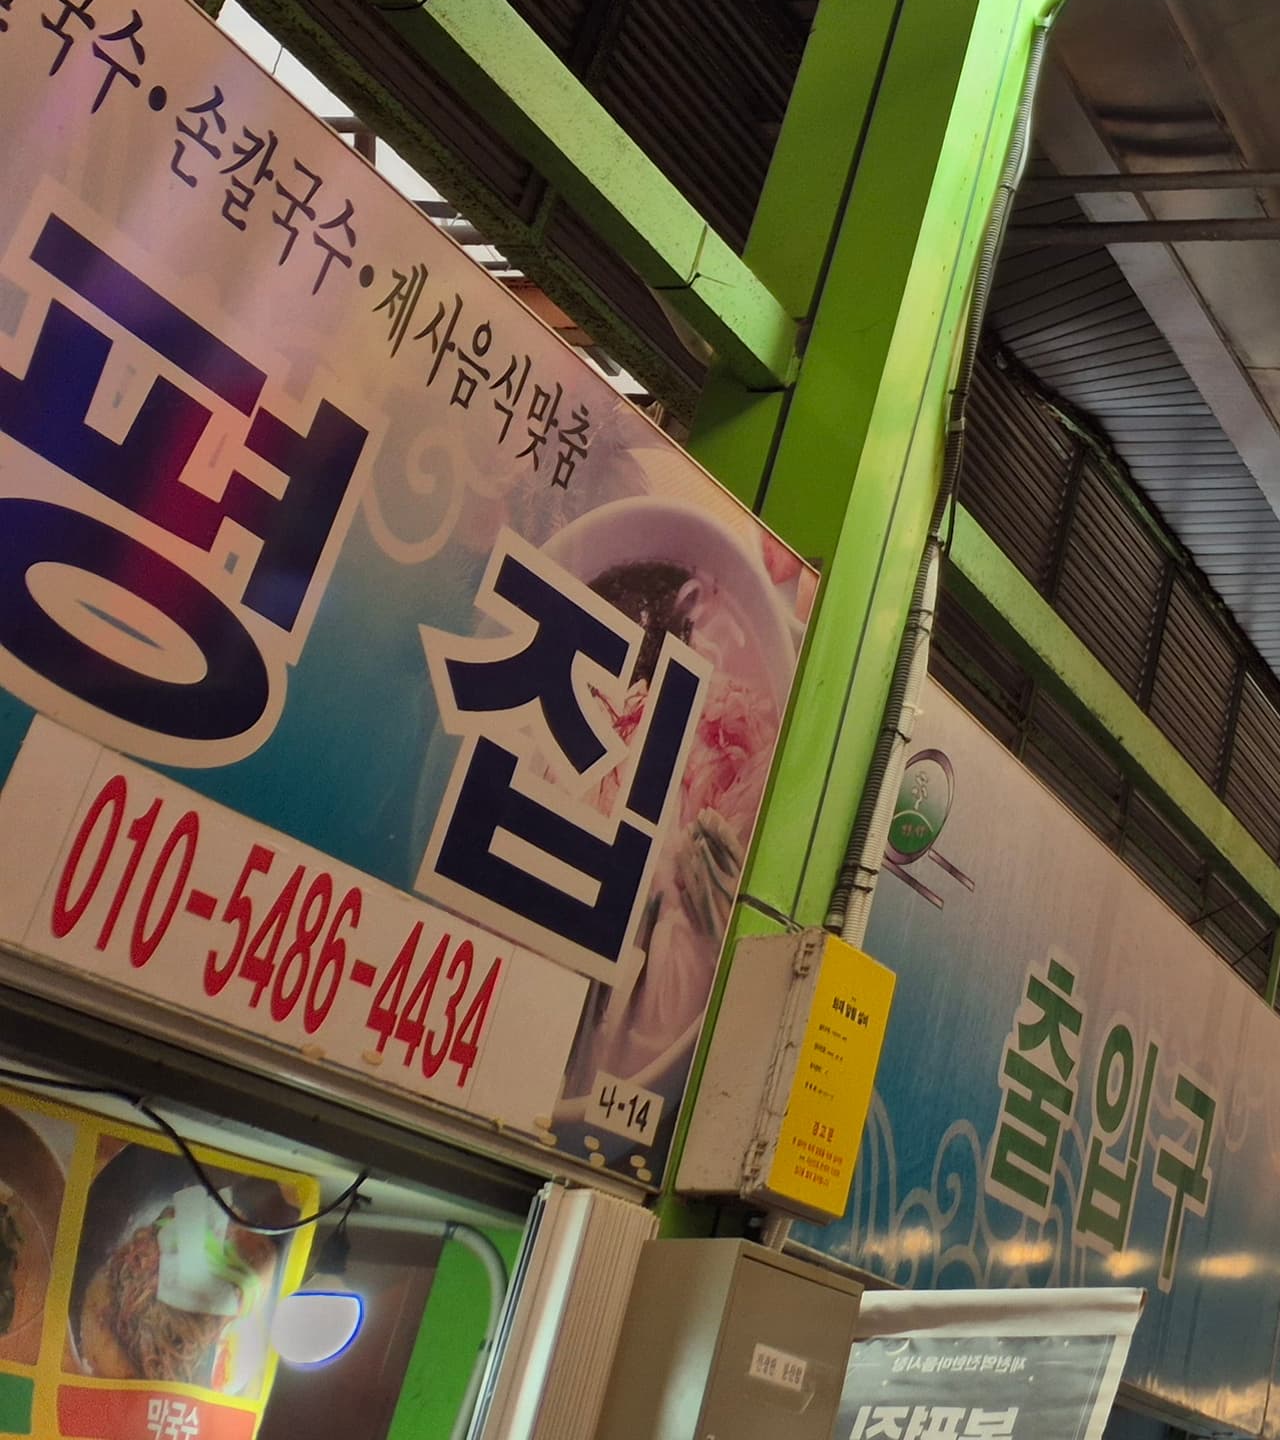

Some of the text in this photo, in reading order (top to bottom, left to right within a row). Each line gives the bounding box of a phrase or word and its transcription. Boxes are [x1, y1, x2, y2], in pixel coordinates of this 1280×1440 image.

[50, 774, 503, 1088] 010-5486-4434
[993, 958, 1217, 1281] 출입구
[146, 1397, 200, 1440] 막국수
